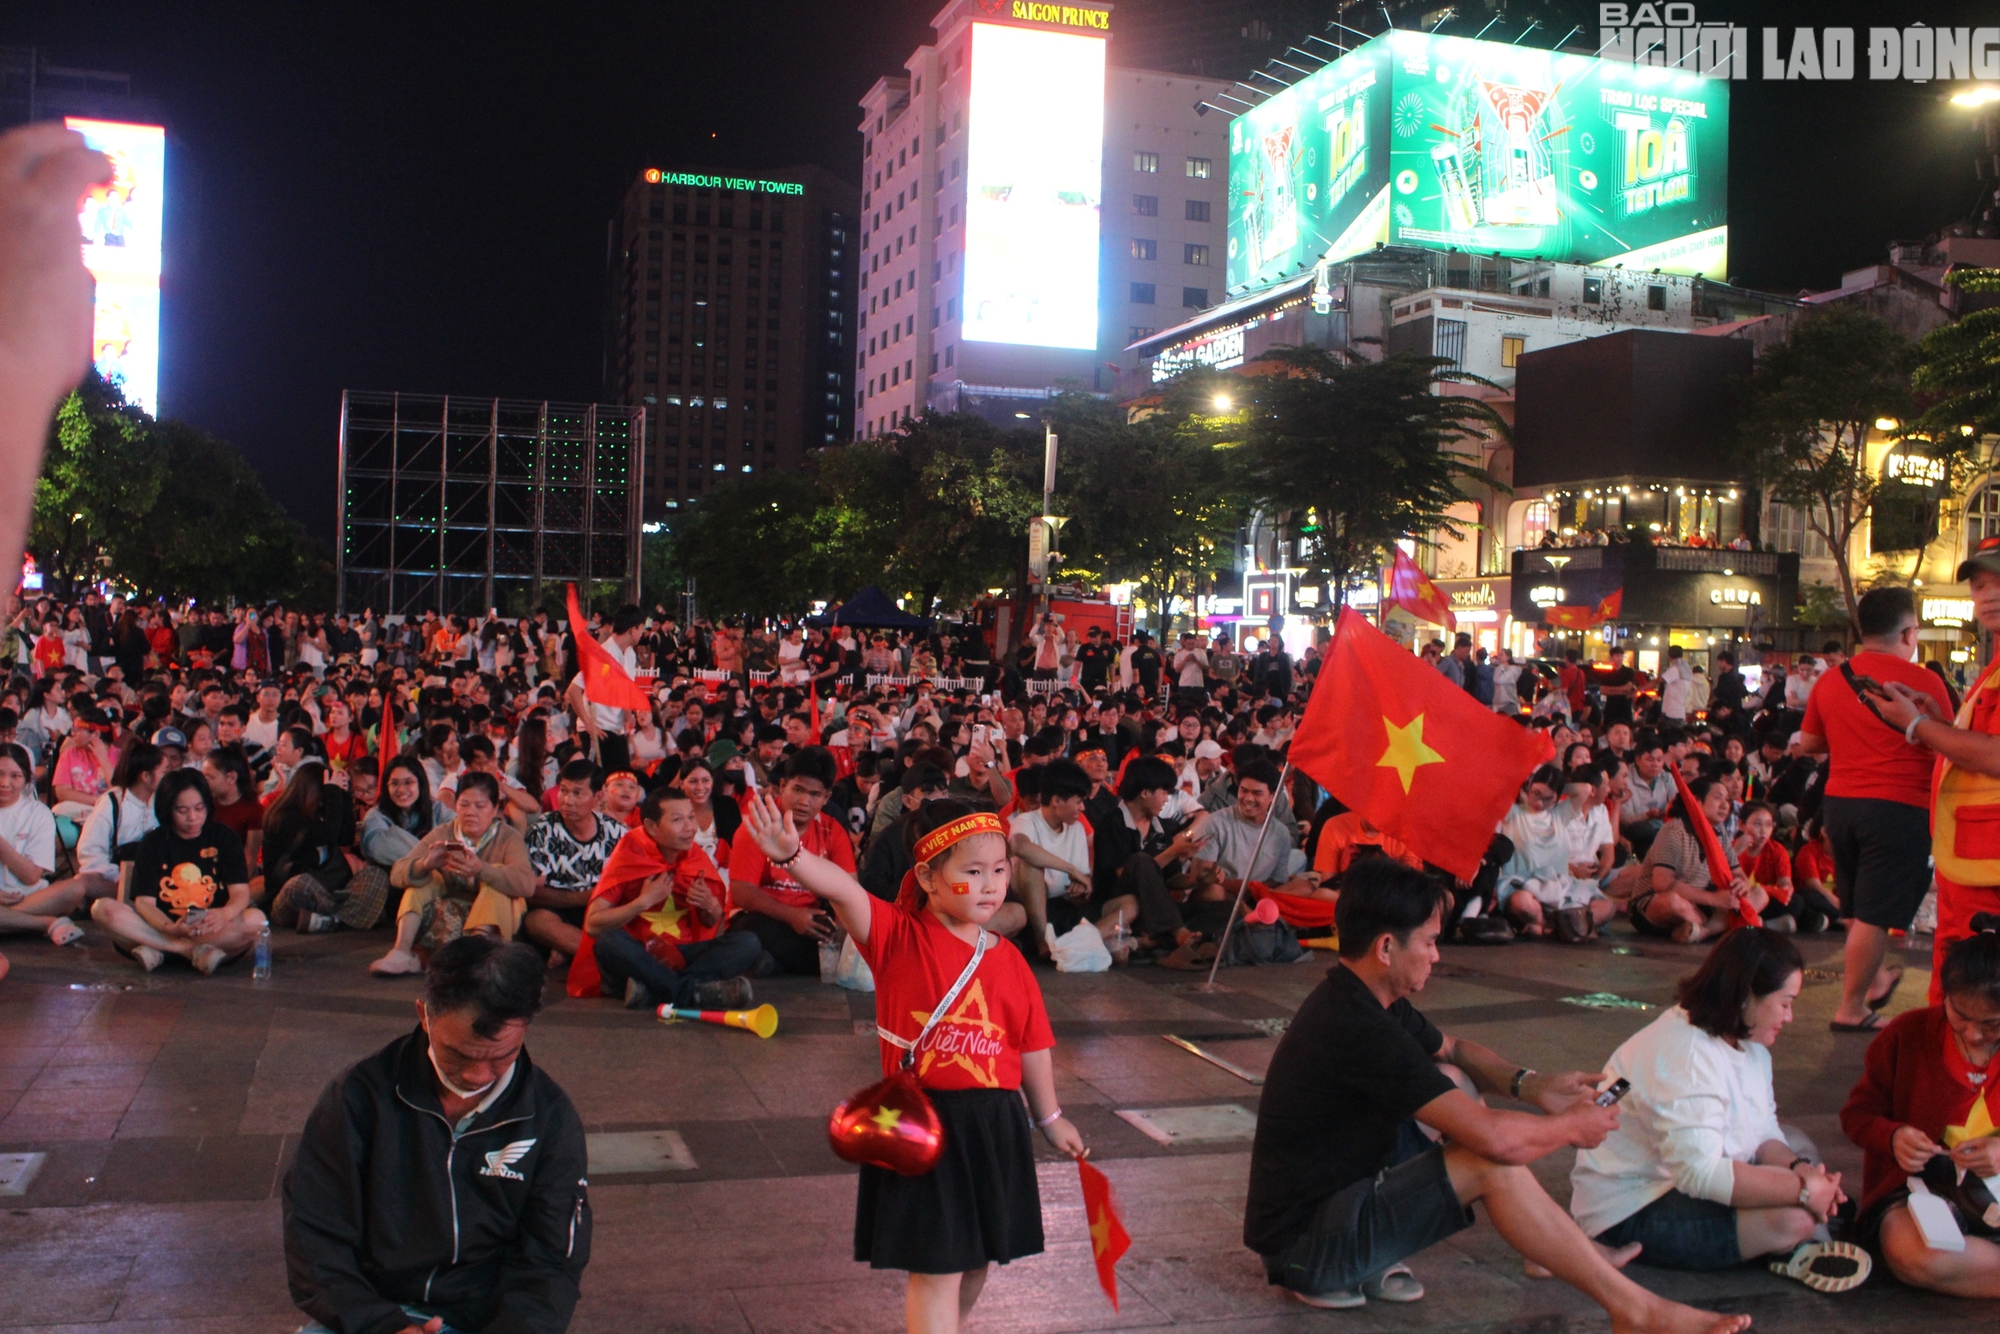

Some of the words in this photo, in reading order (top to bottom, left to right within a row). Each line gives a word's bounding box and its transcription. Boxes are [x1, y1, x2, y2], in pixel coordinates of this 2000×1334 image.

[1012, 0, 1060, 23] SAIGON
[1062, 6, 1109, 30] PRINCE
[1659, 97, 1708, 119] SPECIAL
[661, 171, 722, 188] HARBOUR
[725, 177, 756, 191] VIEW
[759, 180, 804, 195] TOWER
[1196, 331, 1244, 367] GARDEN
[926, 831, 950, 851] VIỆT
[951, 820, 978, 836] NAM
[921, 1025, 965, 1059] Việt
[960, 1030, 1003, 1057] Nam
[479, 1166, 524, 1181] HONDA
